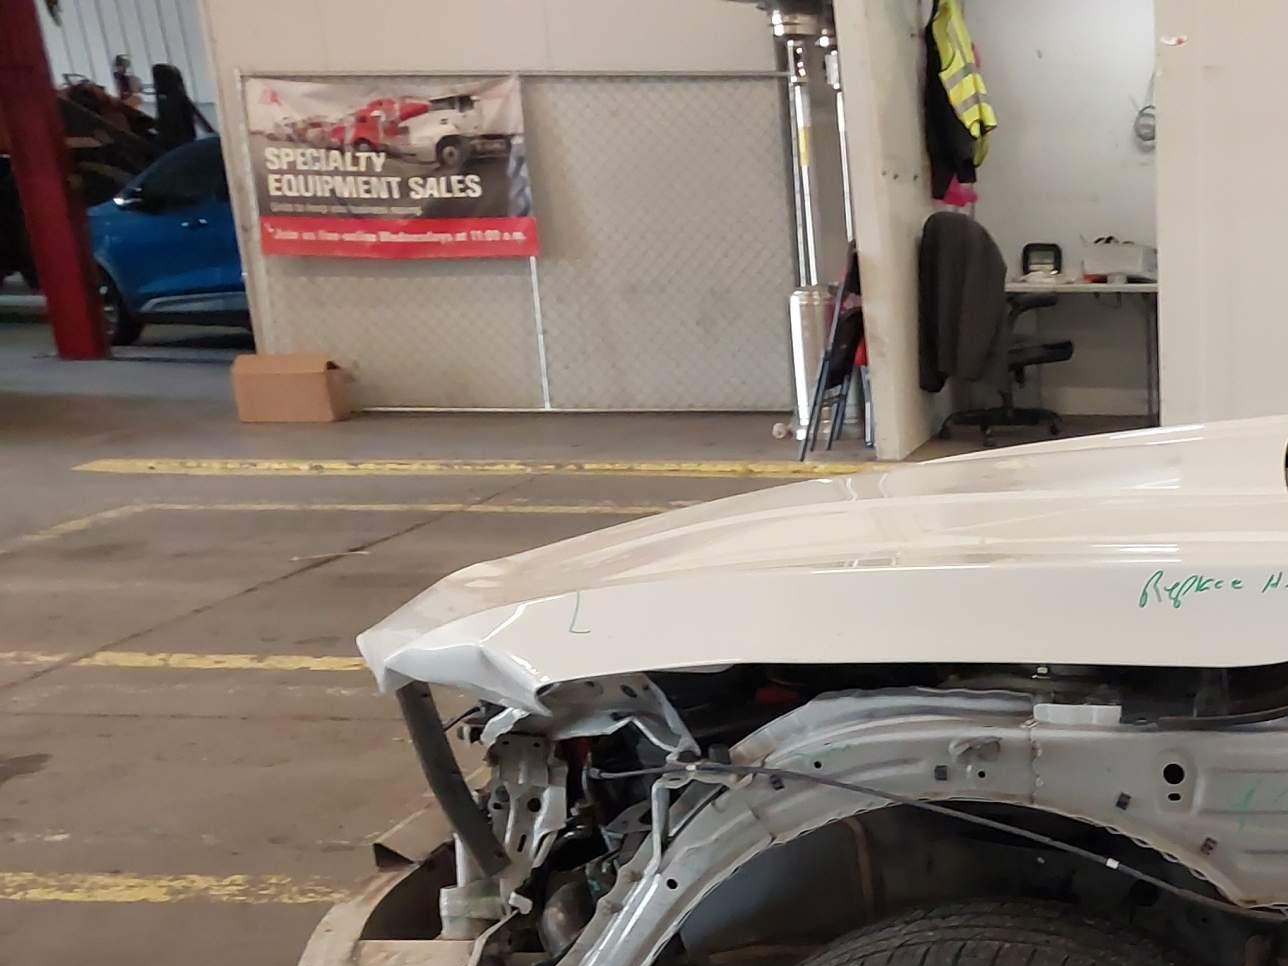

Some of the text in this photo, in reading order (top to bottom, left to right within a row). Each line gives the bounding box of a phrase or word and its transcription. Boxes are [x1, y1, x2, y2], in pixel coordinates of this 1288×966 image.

[264, 147, 386, 172] SPECIALTY
[267, 174, 483, 199] EQUIPMENT SALES
